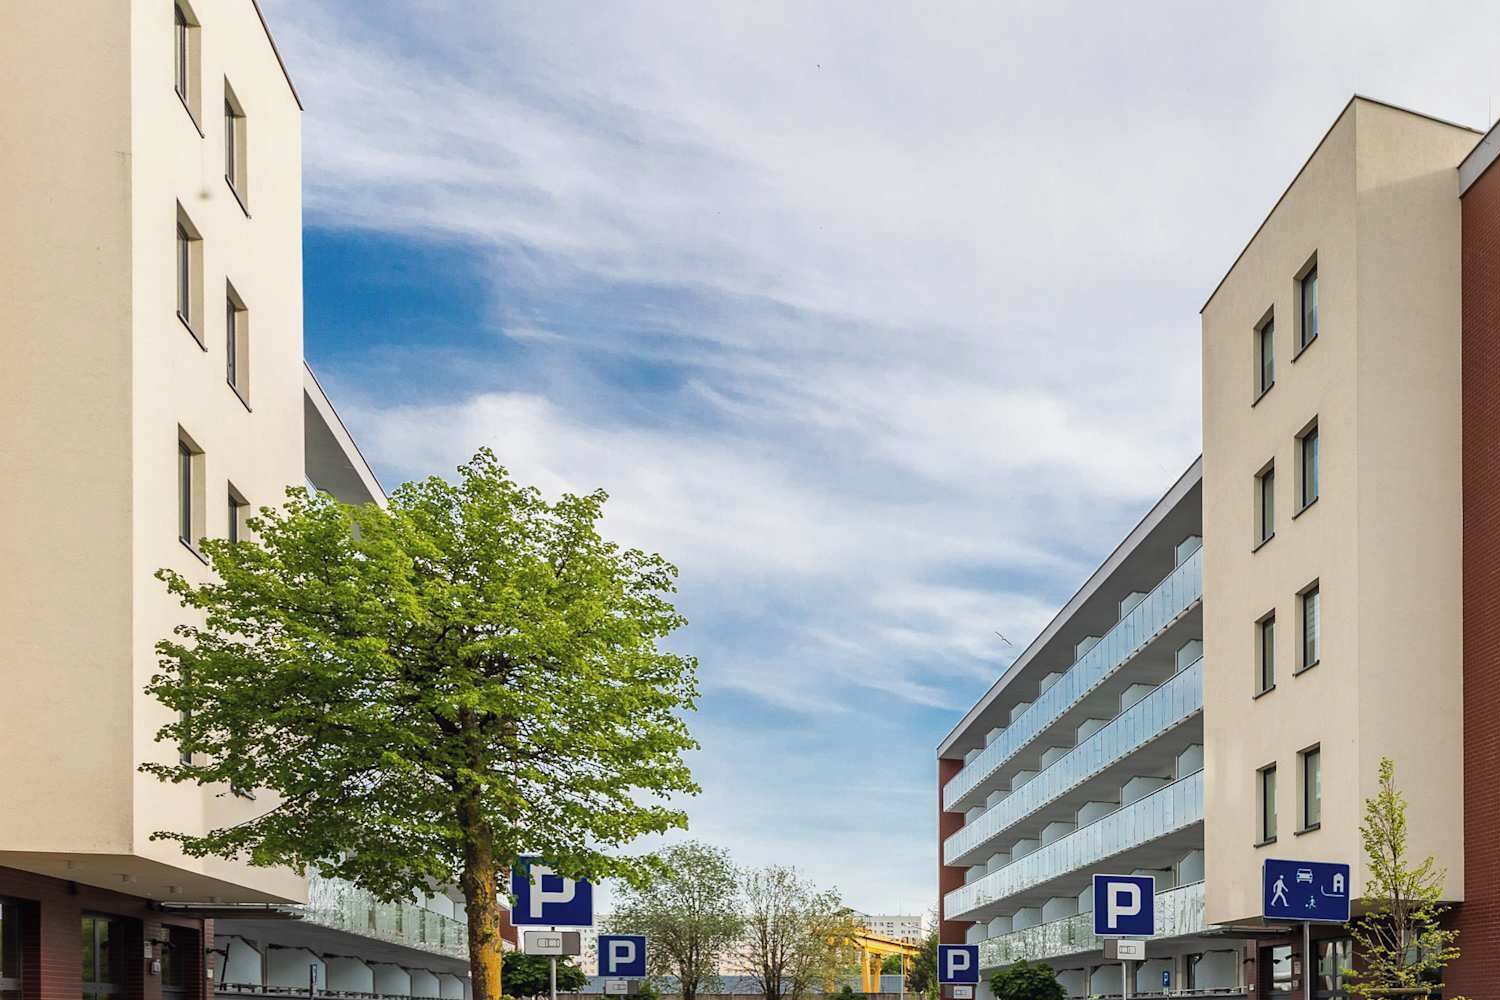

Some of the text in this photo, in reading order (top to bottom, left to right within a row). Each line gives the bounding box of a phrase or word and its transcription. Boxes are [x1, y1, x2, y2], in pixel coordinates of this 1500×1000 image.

[530, 863, 575, 918] P
[1107, 882, 1141, 928] P
[609, 940, 636, 973] P
[947, 949, 970, 979] P
